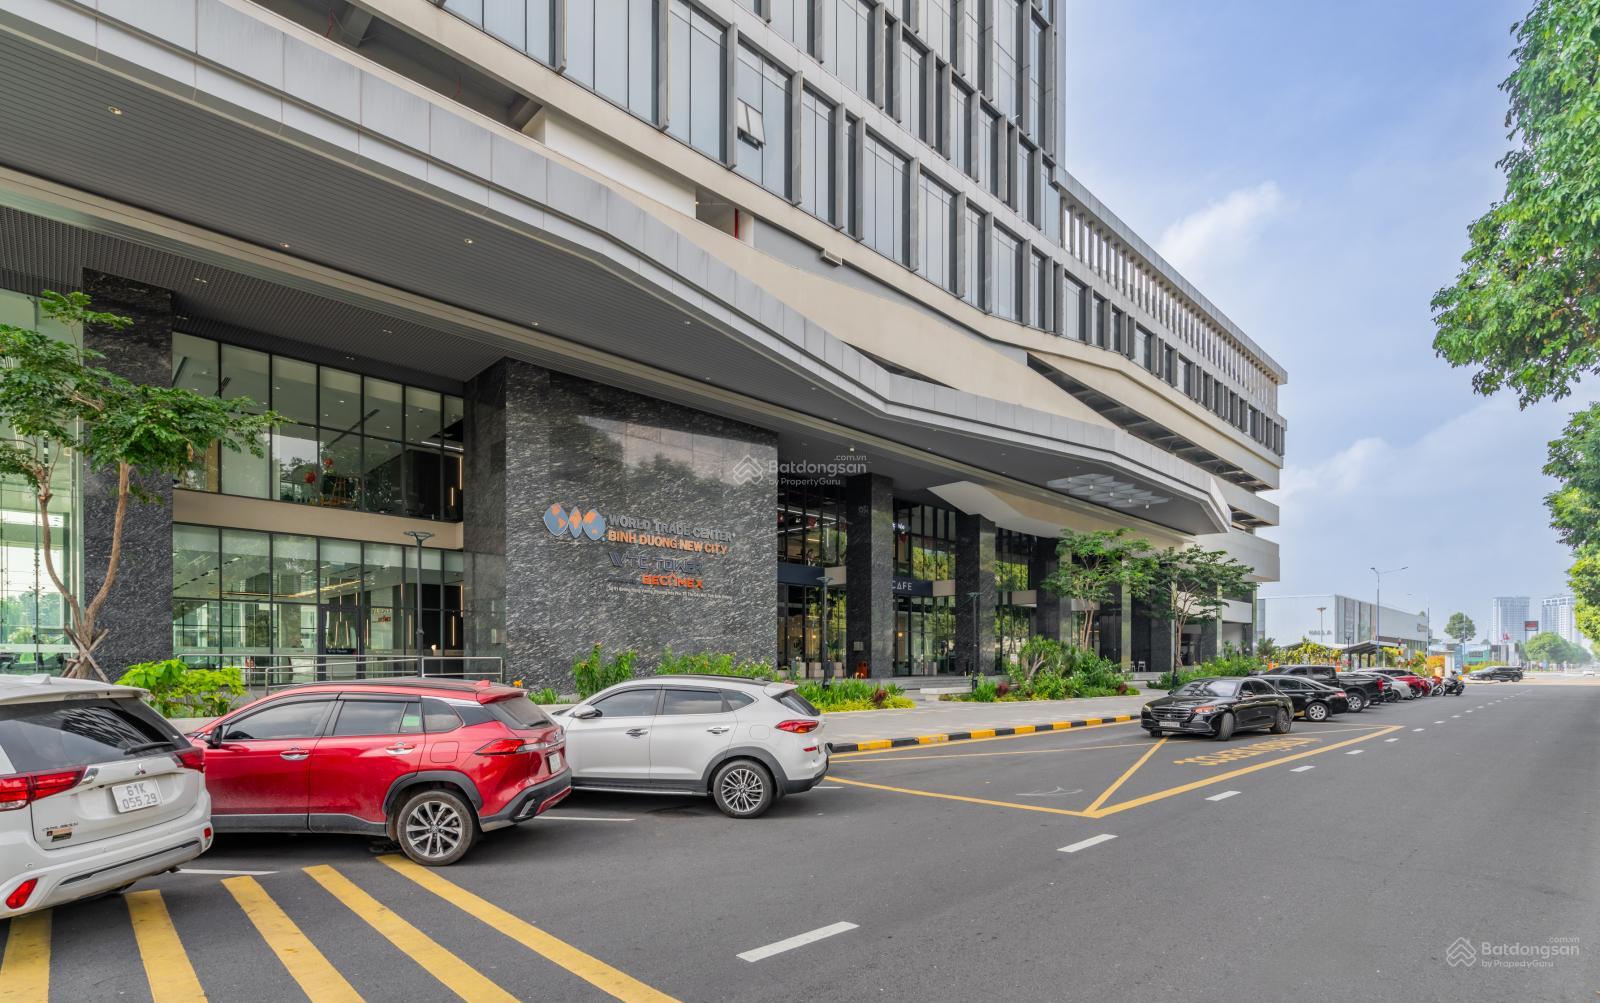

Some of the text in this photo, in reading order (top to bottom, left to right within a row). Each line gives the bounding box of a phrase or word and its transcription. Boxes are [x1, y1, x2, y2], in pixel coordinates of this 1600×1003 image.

[609, 514, 731, 542] WORLD TRADE CENTER
[608, 529, 729, 556] BINH DUONG NEW CITY
[656, 556, 703, 574] TOWER
[641, 571, 703, 588] BECOMEX
[126, 782, 146, 797] 61K
[122, 792, 158, 810] 055.29
